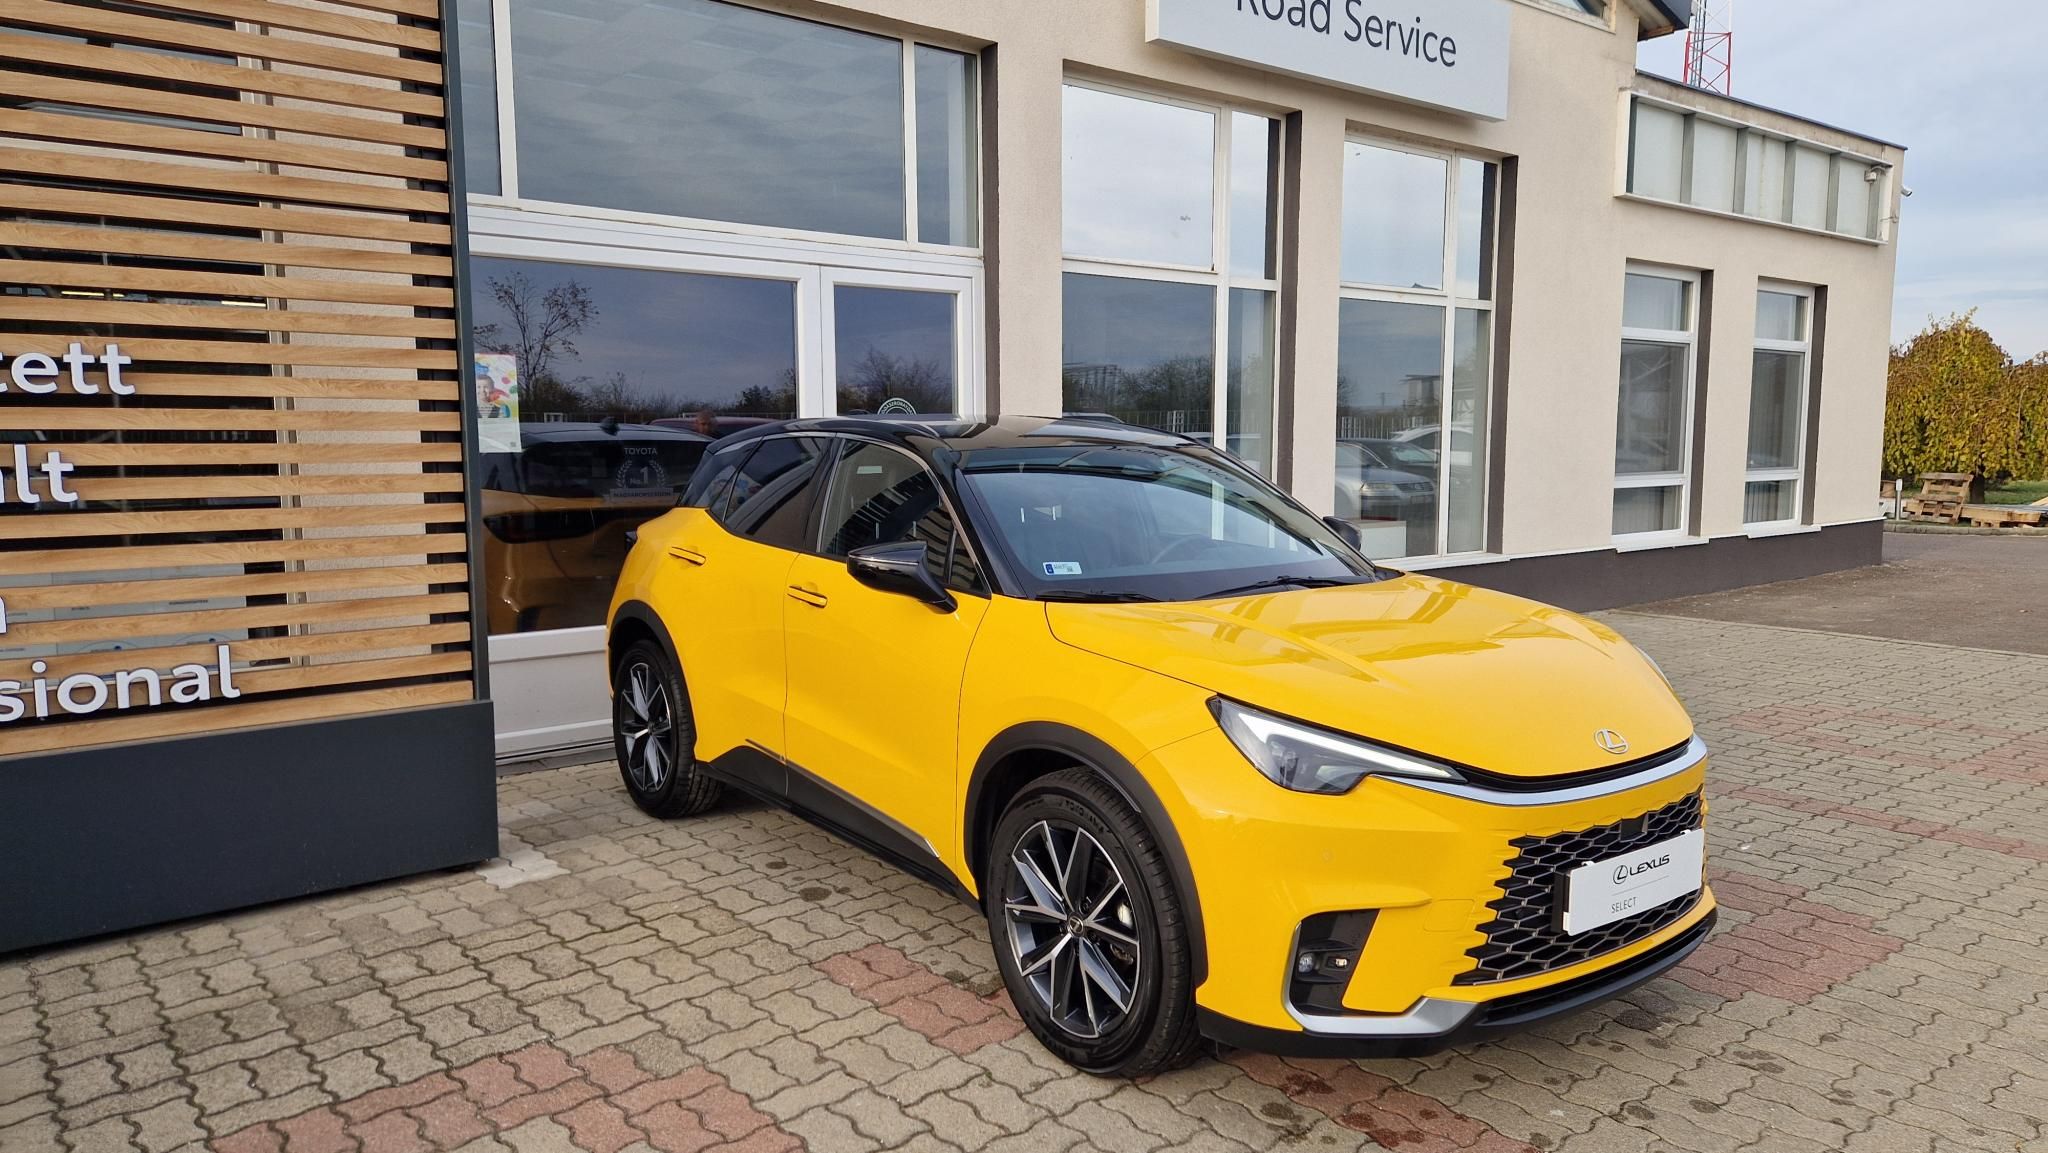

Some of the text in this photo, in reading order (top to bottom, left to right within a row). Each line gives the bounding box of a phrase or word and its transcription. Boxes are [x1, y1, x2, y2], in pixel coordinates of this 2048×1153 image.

[1237, 0, 1457, 68] oad Service
[0, 342, 136, 395] ett
[0, 444, 78, 504] lt
[624, 447, 658, 455] TOYOTA
[0, 644, 241, 722] sional
[1630, 854, 1670, 876] LEXUS
[1611, 896, 1637, 913] SELECT
